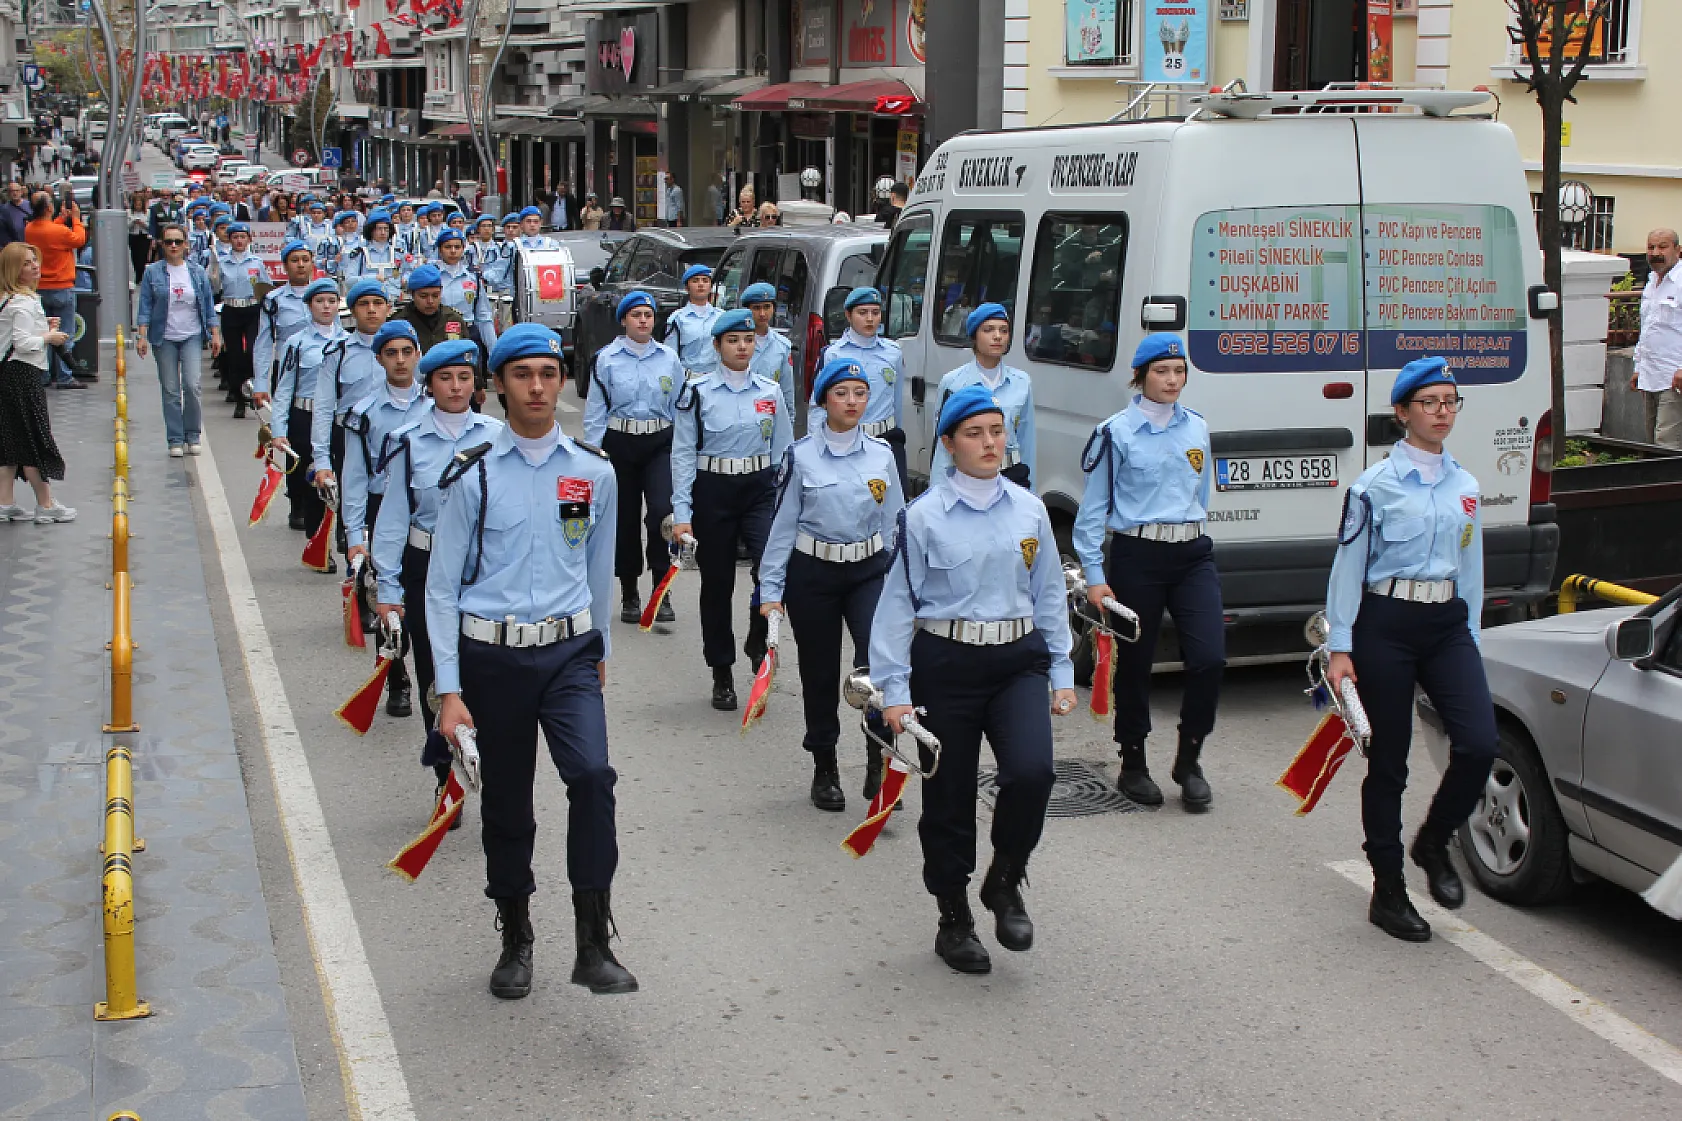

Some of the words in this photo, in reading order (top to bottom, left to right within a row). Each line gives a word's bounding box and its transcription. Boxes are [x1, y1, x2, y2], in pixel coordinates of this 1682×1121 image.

[1165, 58, 1182, 69] 25
[323, 149, 332, 164] P
[1218, 221, 1285, 241] Menteşeli
[1289, 217, 1353, 238] SİNEKLİK
[1378, 222, 1398, 238] PVC
[1401, 222, 1424, 242] Kapı
[1426, 226, 1438, 239] ve
[1441, 222, 1482, 240] Pencere
[1219, 249, 1255, 265] Pileli
[1258, 245, 1324, 265] SİNEKLİK
[1379, 249, 1399, 265] PVC
[1402, 249, 1444, 265] Pencere
[1446, 249, 1484, 267] Contası
[1220, 271, 1299, 298] DUŞKABİNİ
[1379, 276, 1399, 293] PVC
[1402, 276, 1444, 293] Pencere
[1446, 277, 1465, 298] Çift
[1467, 277, 1498, 299] Açılım
[1220, 299, 1281, 320] LAMİNAT
[1284, 303, 1330, 320] PARKE
[1379, 303, 1399, 320] PVC
[1402, 303, 1444, 320] Pencere
[1446, 303, 1478, 320] Bakım
[1480, 304, 1516, 321] Onarım
[1218, 332, 1269, 354] 0532
[1272, 332, 1310, 354] 526
[1313, 332, 1340, 354] 07
[1341, 332, 1360, 354] 16
[1396, 333, 1461, 351] ÖZDEMİR
[1462, 333, 1513, 354] İNŞAAT
[1229, 461, 1250, 481] 28
[1262, 459, 1294, 481] ACS
[1300, 458, 1332, 479] 658
[1207, 509, 1261, 522] ENAULT
